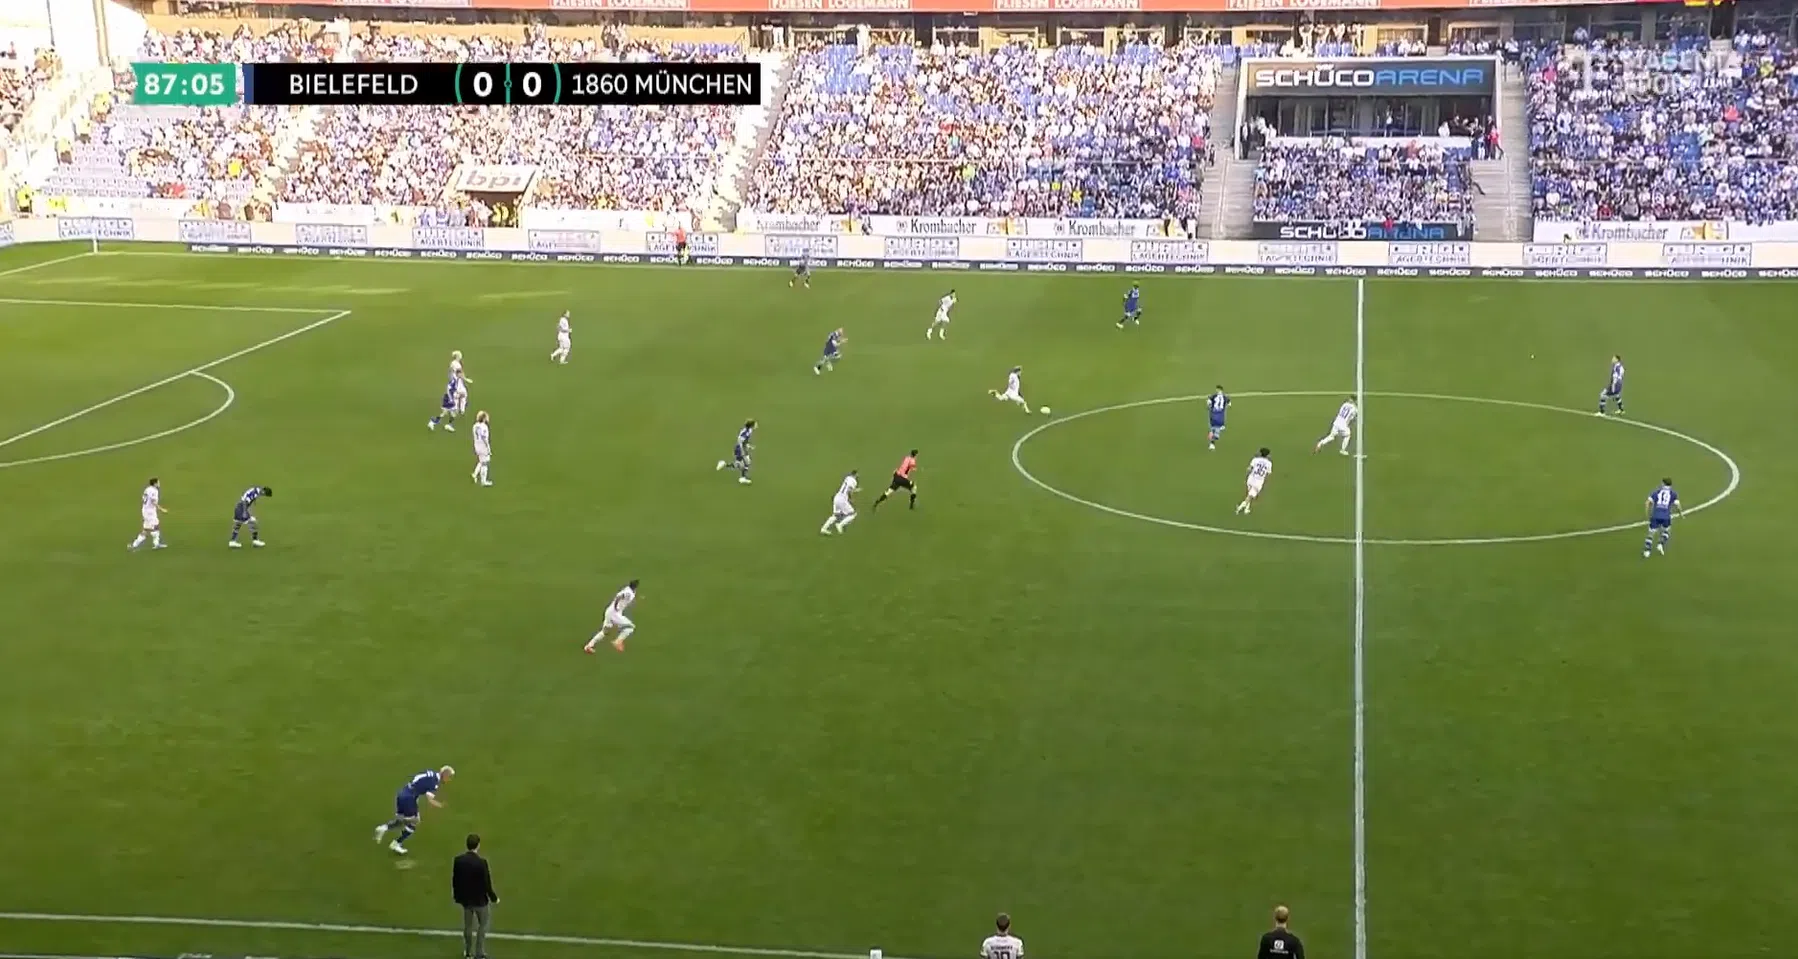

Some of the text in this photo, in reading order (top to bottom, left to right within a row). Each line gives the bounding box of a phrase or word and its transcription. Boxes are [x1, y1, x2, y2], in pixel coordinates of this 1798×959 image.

[466, 170, 522, 188] bpi
[911, 218, 977, 234] Krombacher
[1069, 220, 1135, 236] Krombacher
[1592, 222, 1668, 239] Krombacher
